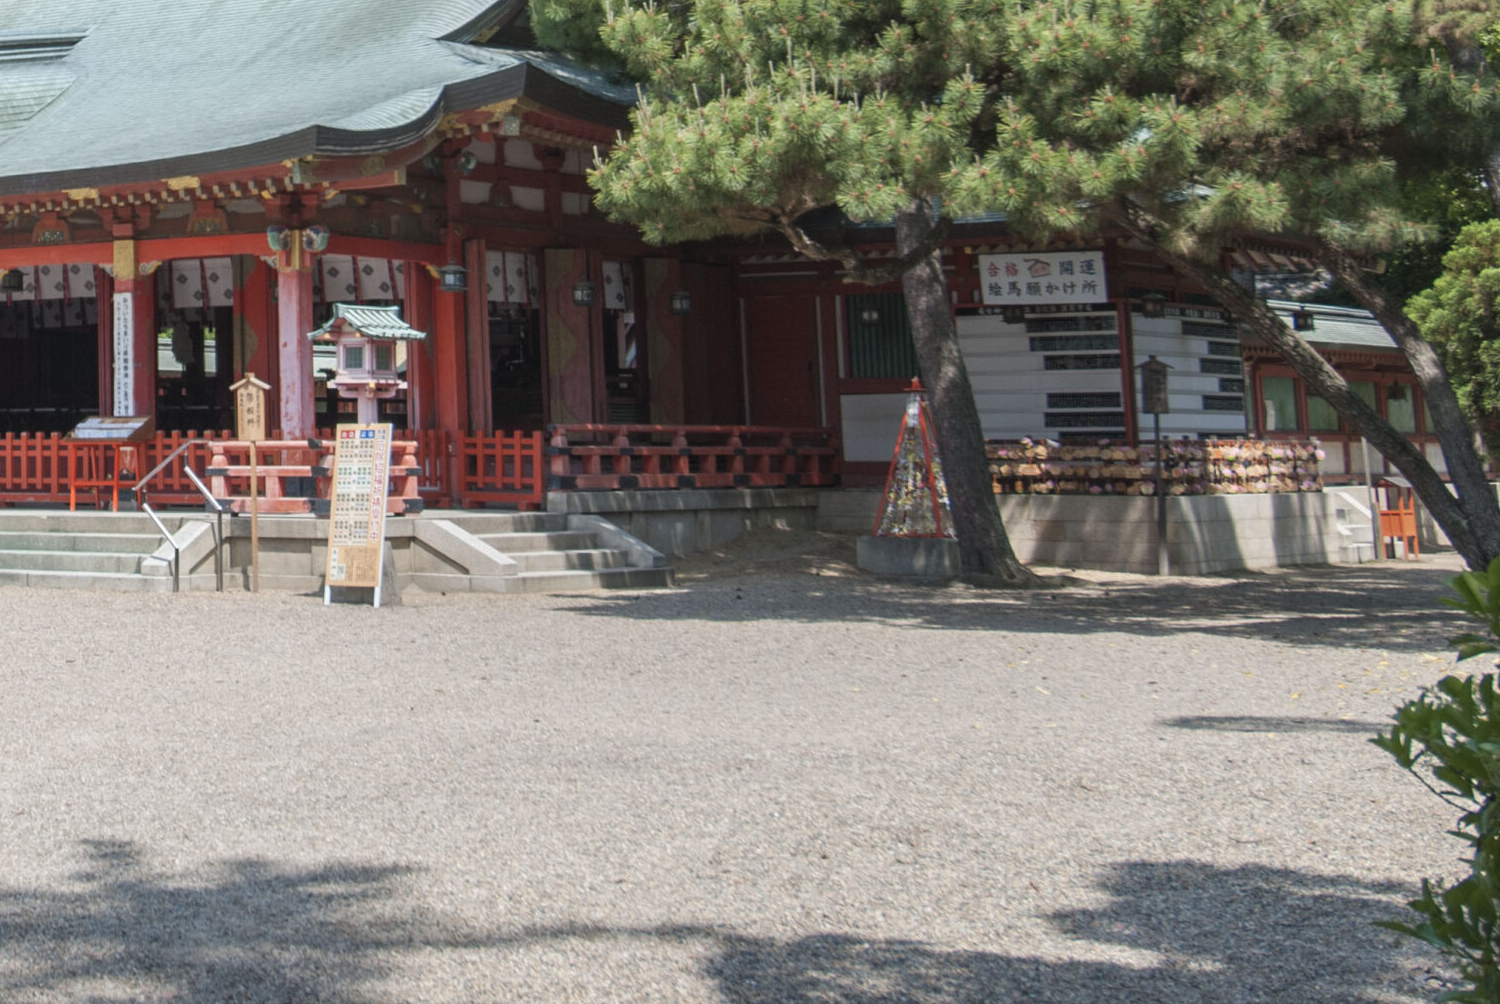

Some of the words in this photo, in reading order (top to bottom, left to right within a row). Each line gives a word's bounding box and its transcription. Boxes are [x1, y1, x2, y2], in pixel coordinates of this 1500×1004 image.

[988, 261, 1019, 277] 合格
[1059, 259, 1097, 276] 開運
[988, 280, 1099, 297] 絵馬願かけ所
